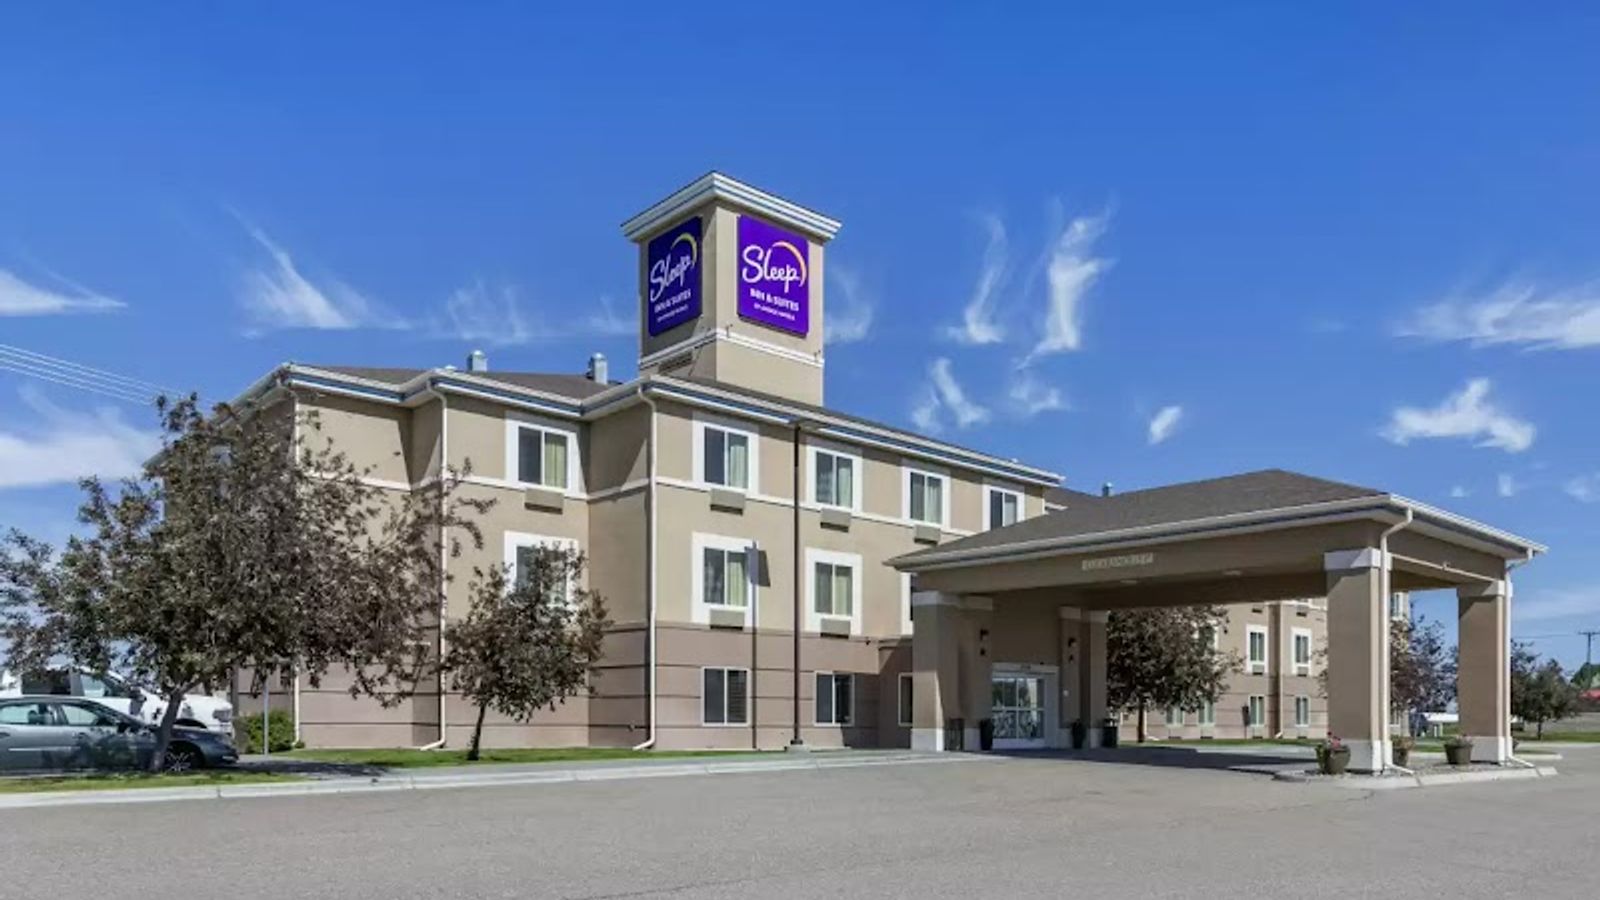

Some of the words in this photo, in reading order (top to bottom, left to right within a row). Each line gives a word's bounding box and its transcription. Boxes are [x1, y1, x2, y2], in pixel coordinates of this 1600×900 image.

[650, 253, 692, 302] Sleep
[742, 245, 800, 293] Sleep
[773, 295, 799, 312] SUITES
